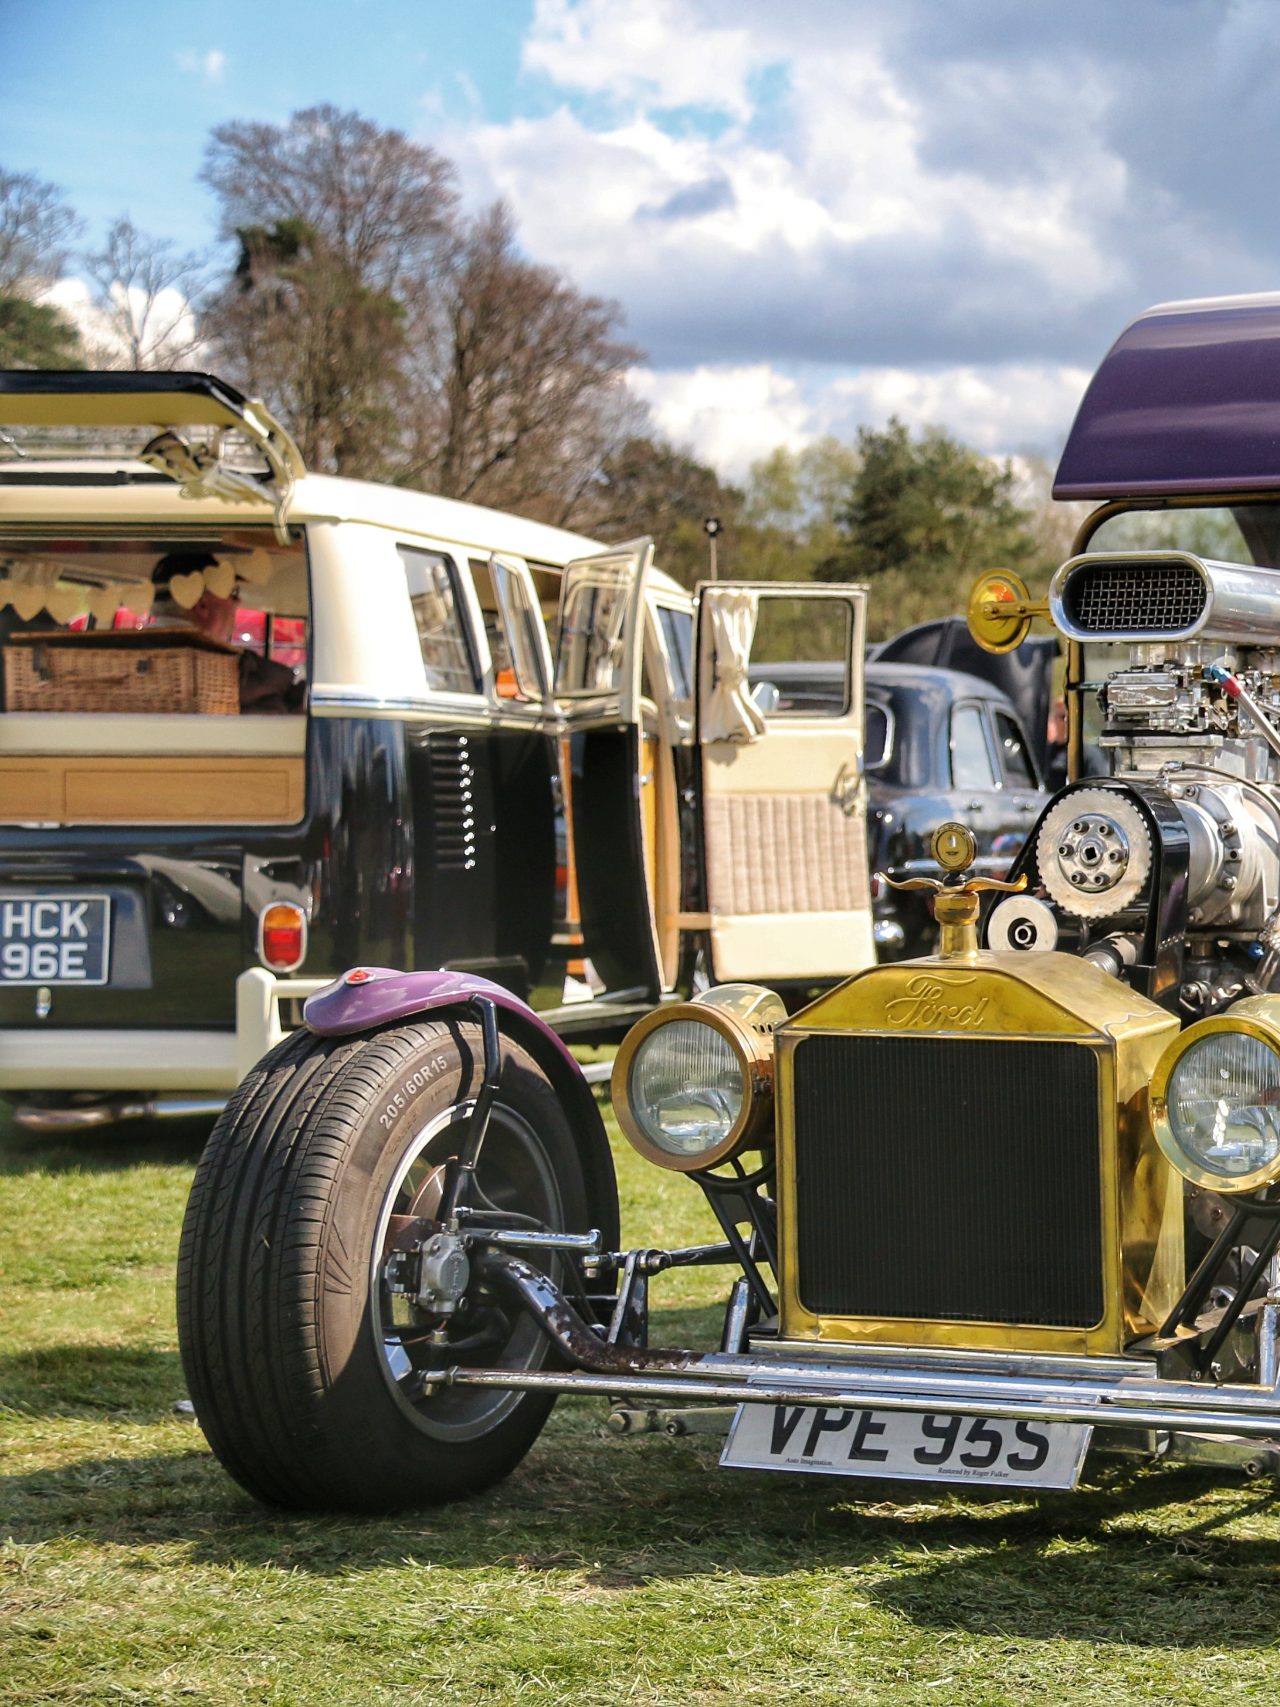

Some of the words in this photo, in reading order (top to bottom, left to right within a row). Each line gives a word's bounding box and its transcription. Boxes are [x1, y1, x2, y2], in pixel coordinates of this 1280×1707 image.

[3, 902, 89, 938] HCK
[1, 943, 88, 979] 96E
[885, 974, 989, 1026] Ford
[380, 1056, 448, 1130] 205/60R15
[770, 1406, 889, 1462] VPE
